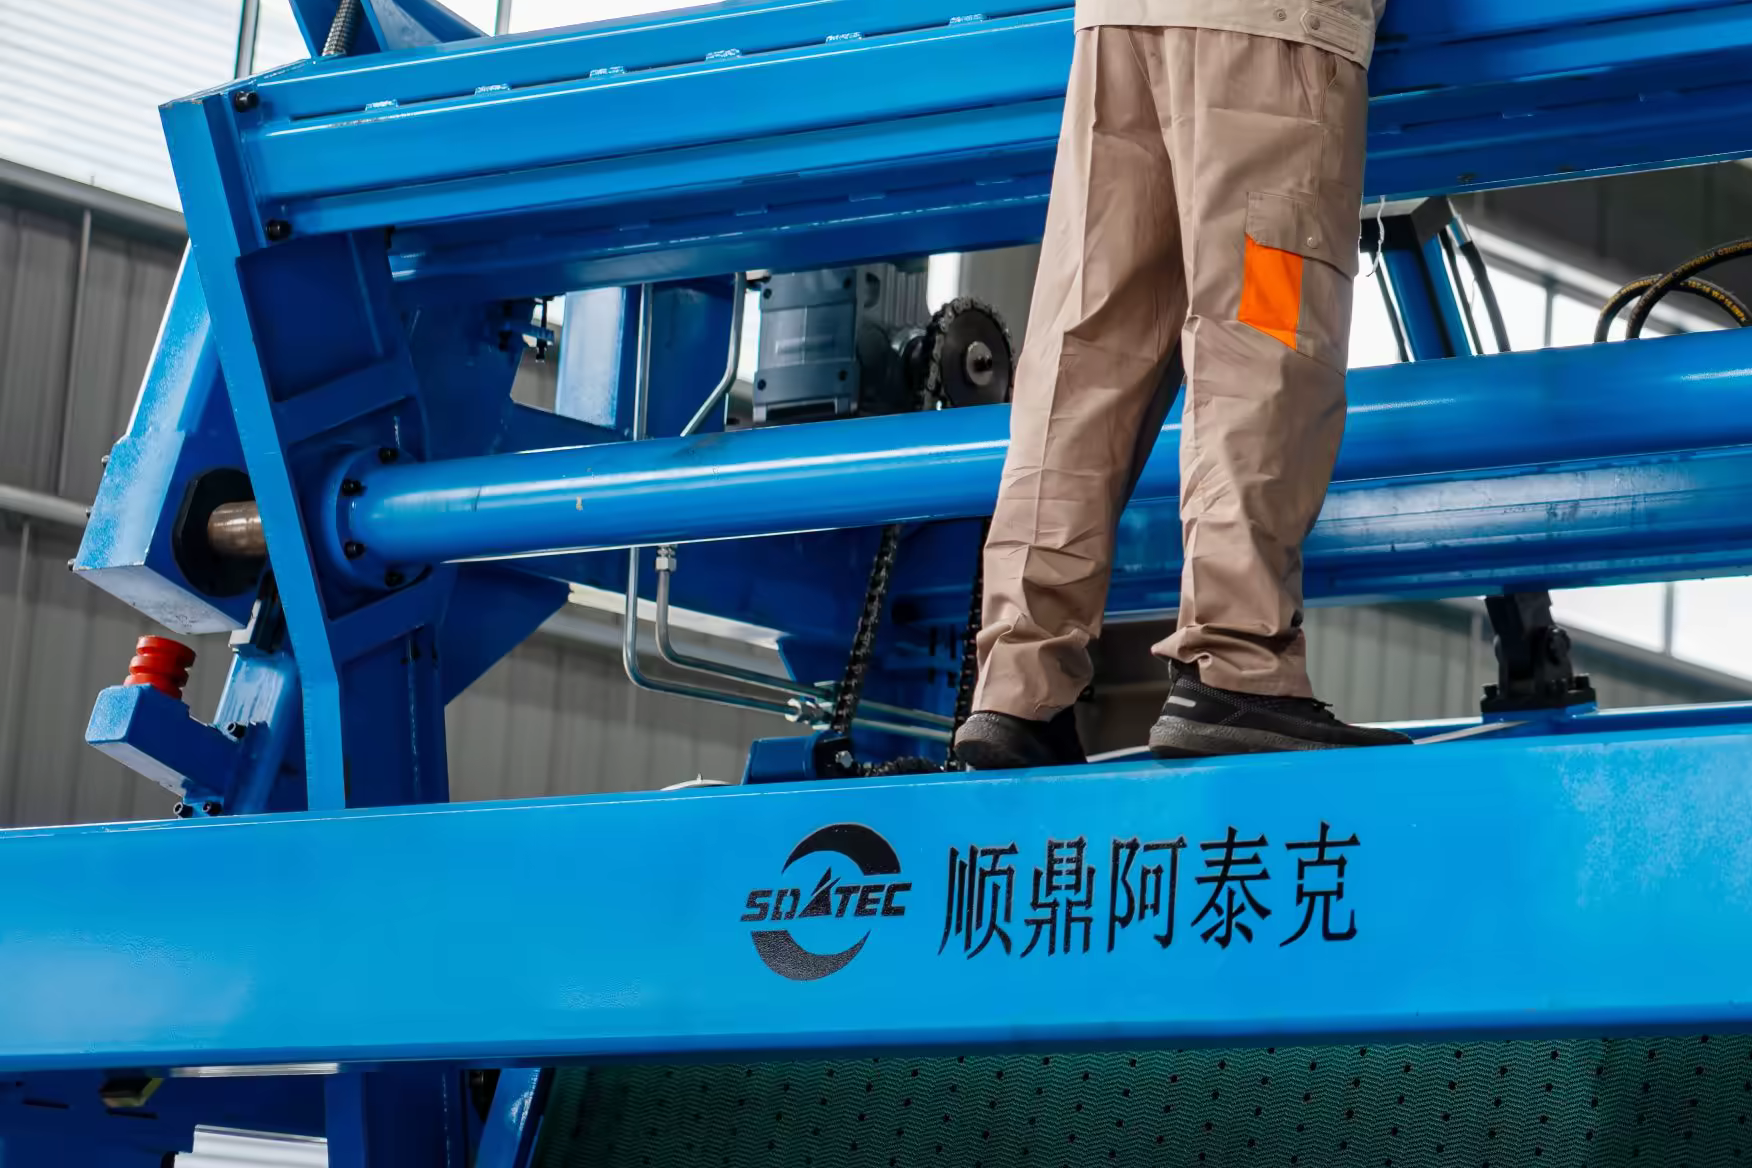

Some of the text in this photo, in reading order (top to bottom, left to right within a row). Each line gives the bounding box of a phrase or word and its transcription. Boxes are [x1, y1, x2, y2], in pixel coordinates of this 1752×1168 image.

[938, 819, 1361, 960] 顺鼎阿泰克
